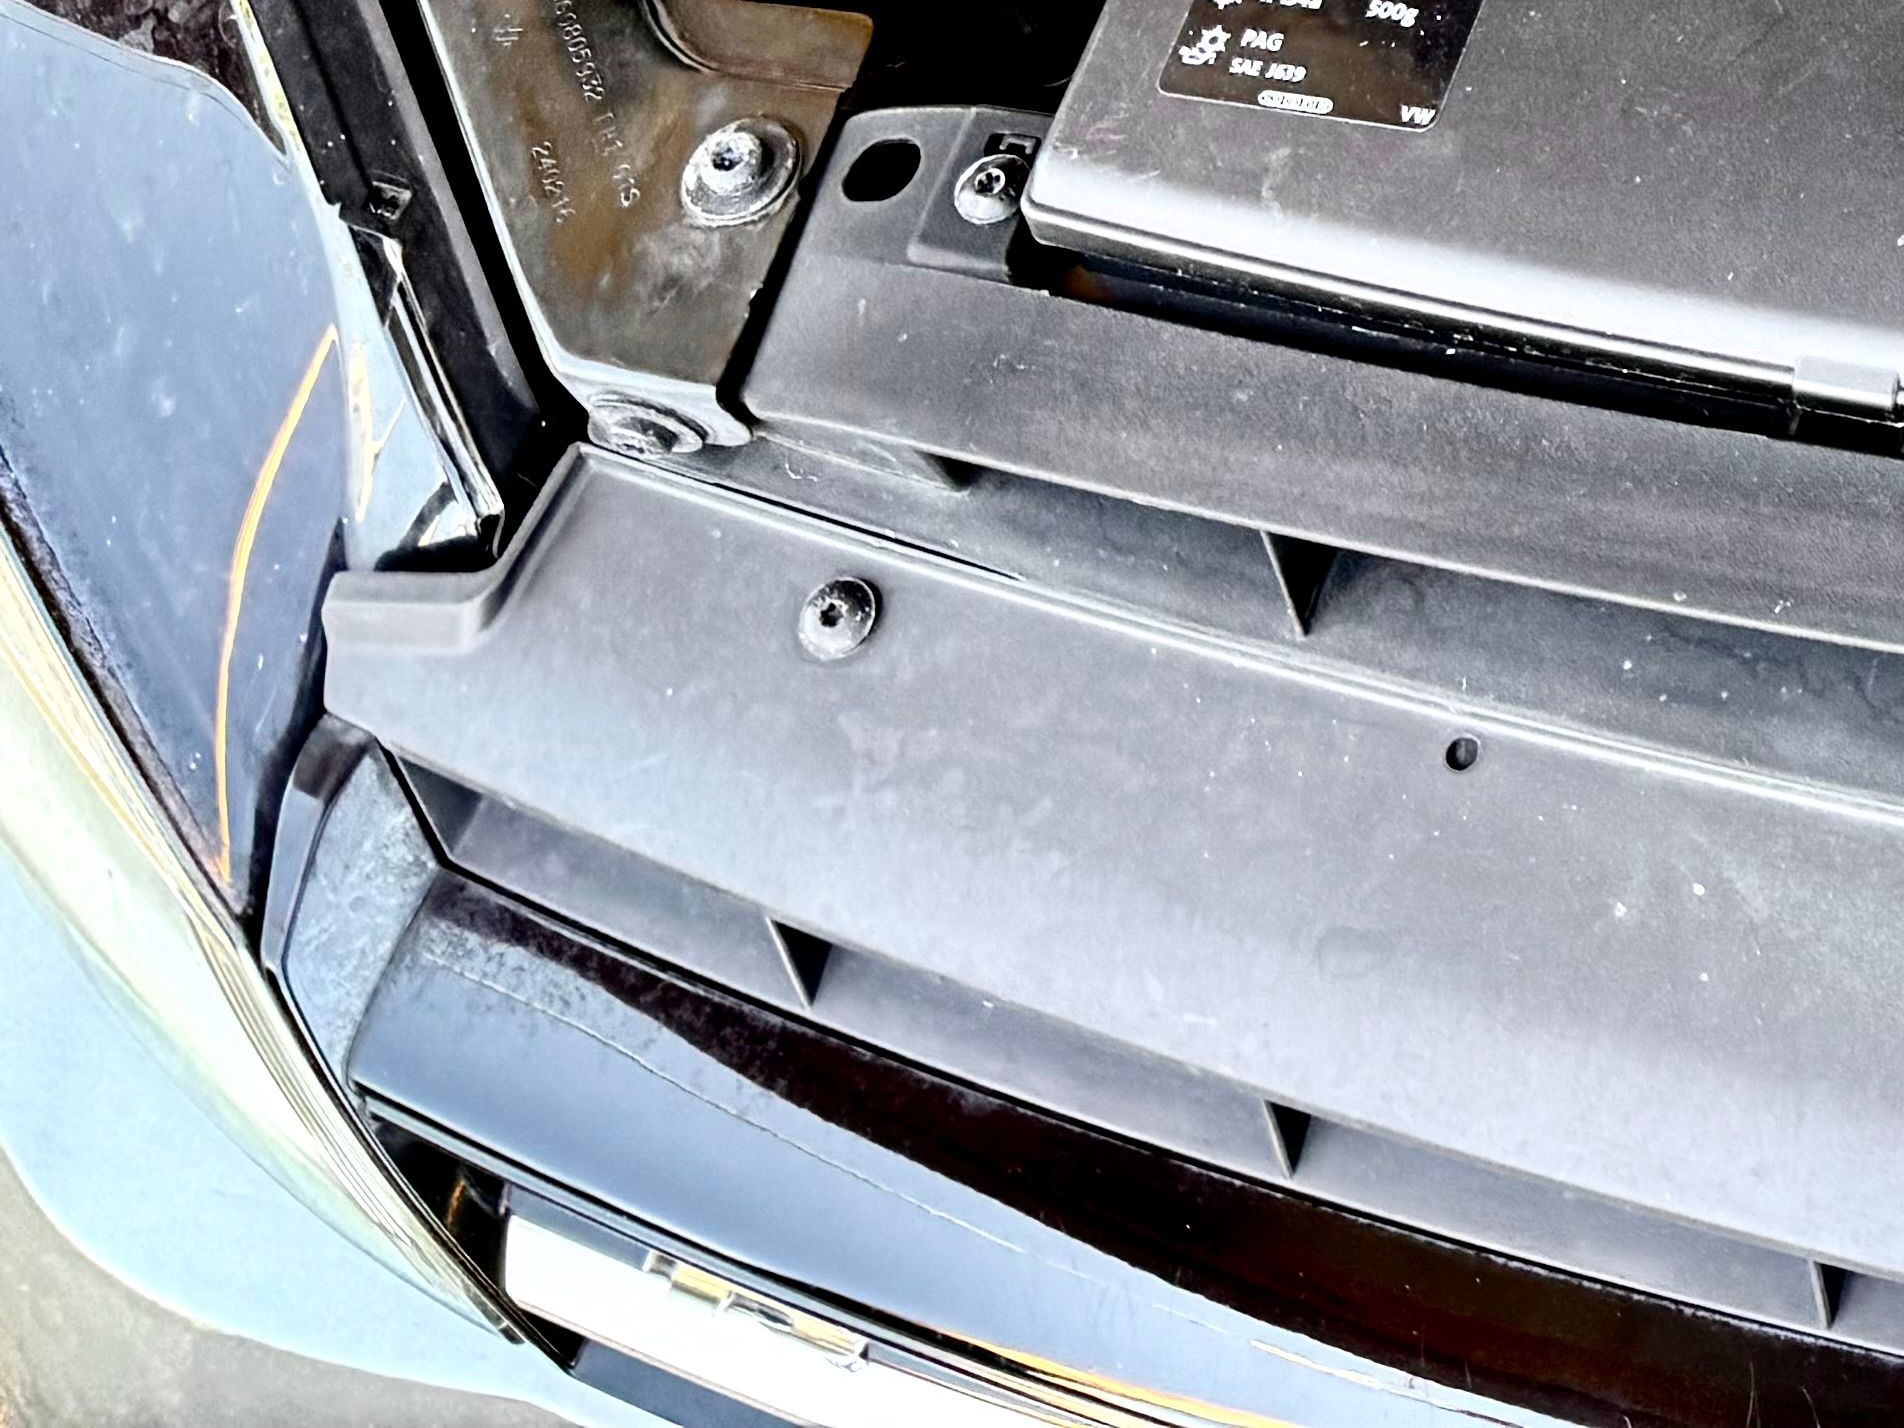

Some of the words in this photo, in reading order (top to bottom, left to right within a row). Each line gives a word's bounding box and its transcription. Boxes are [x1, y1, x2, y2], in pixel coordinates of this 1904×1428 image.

[1365, 0, 1420, 28] 500g
[1240, 28, 1285, 52] PAG
[1229, 57, 1264, 77] SAE
[1401, 105, 1437, 128] VW
